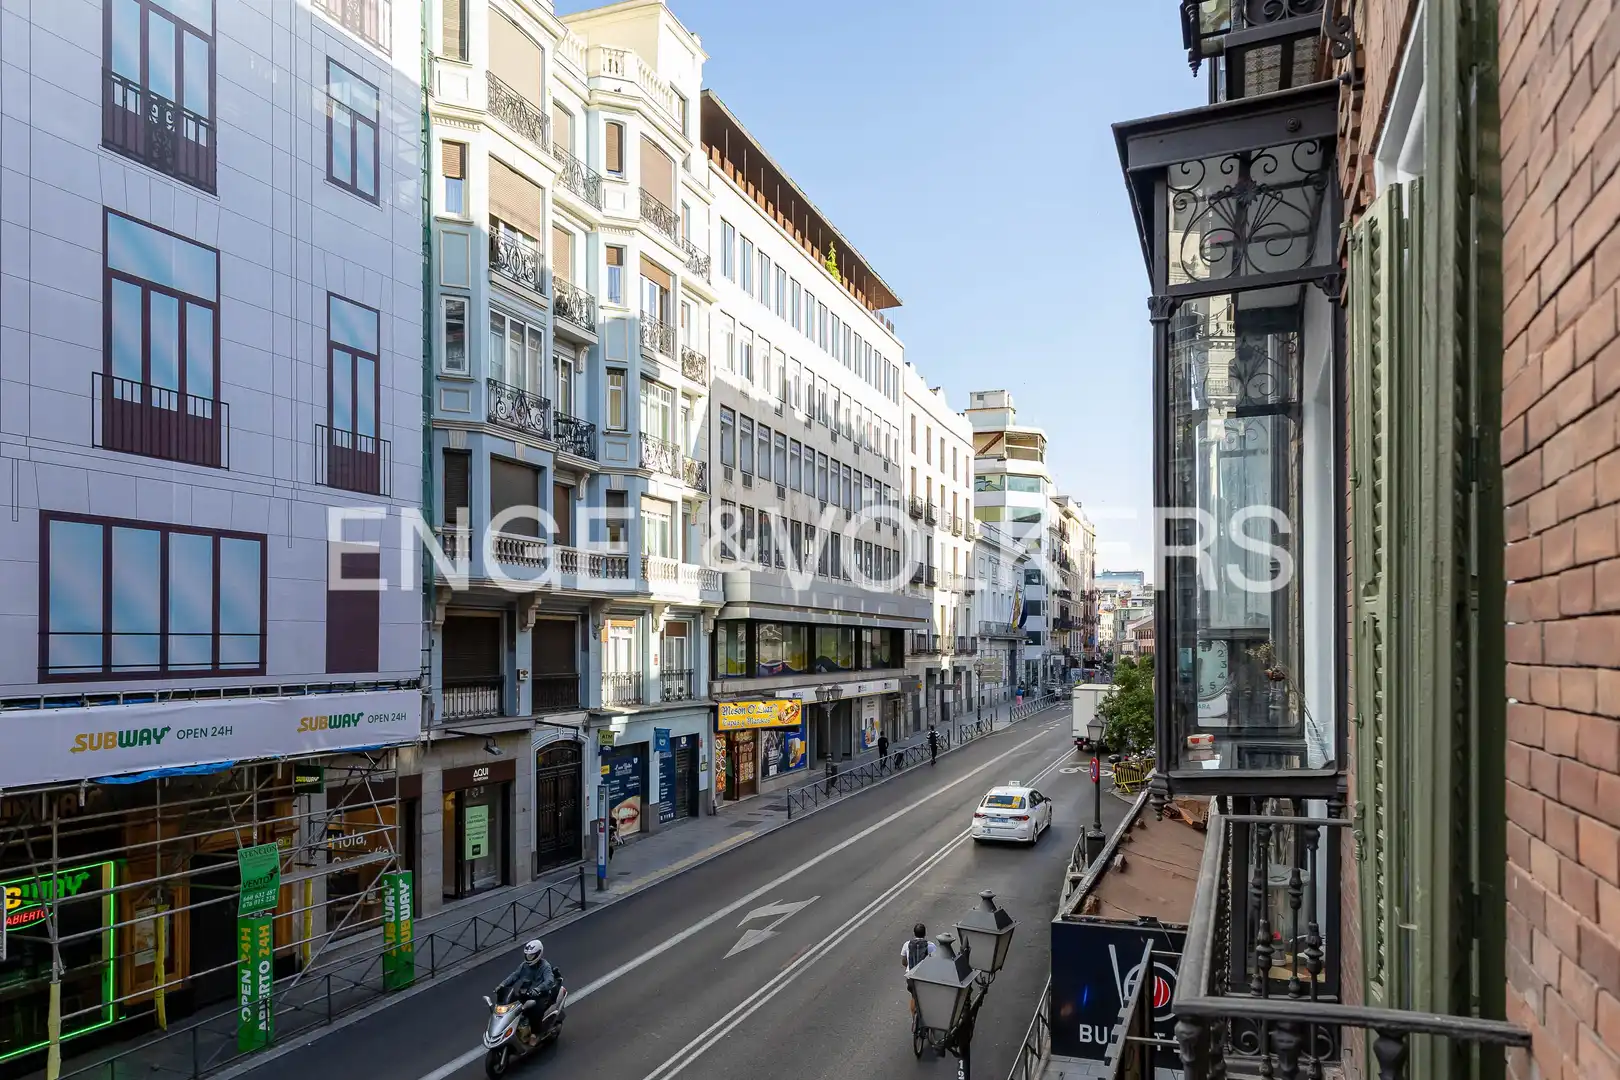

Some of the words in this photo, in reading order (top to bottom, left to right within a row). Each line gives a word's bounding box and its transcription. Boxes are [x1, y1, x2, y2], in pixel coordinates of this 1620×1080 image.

[297, 712, 364, 733] SUBWAY
[367, 714, 388, 724] OPEN
[391, 713, 406, 722] 24H
[70, 726, 171, 753] SUBWAY
[176, 727, 208, 740] OPEN
[211, 725, 233, 737] 24H
[295, 775, 319, 783] SUBWAY
[241, 927, 251, 964] 24H
[258, 924, 270, 957] 24H
[241, 969, 252, 1023] OPEN
